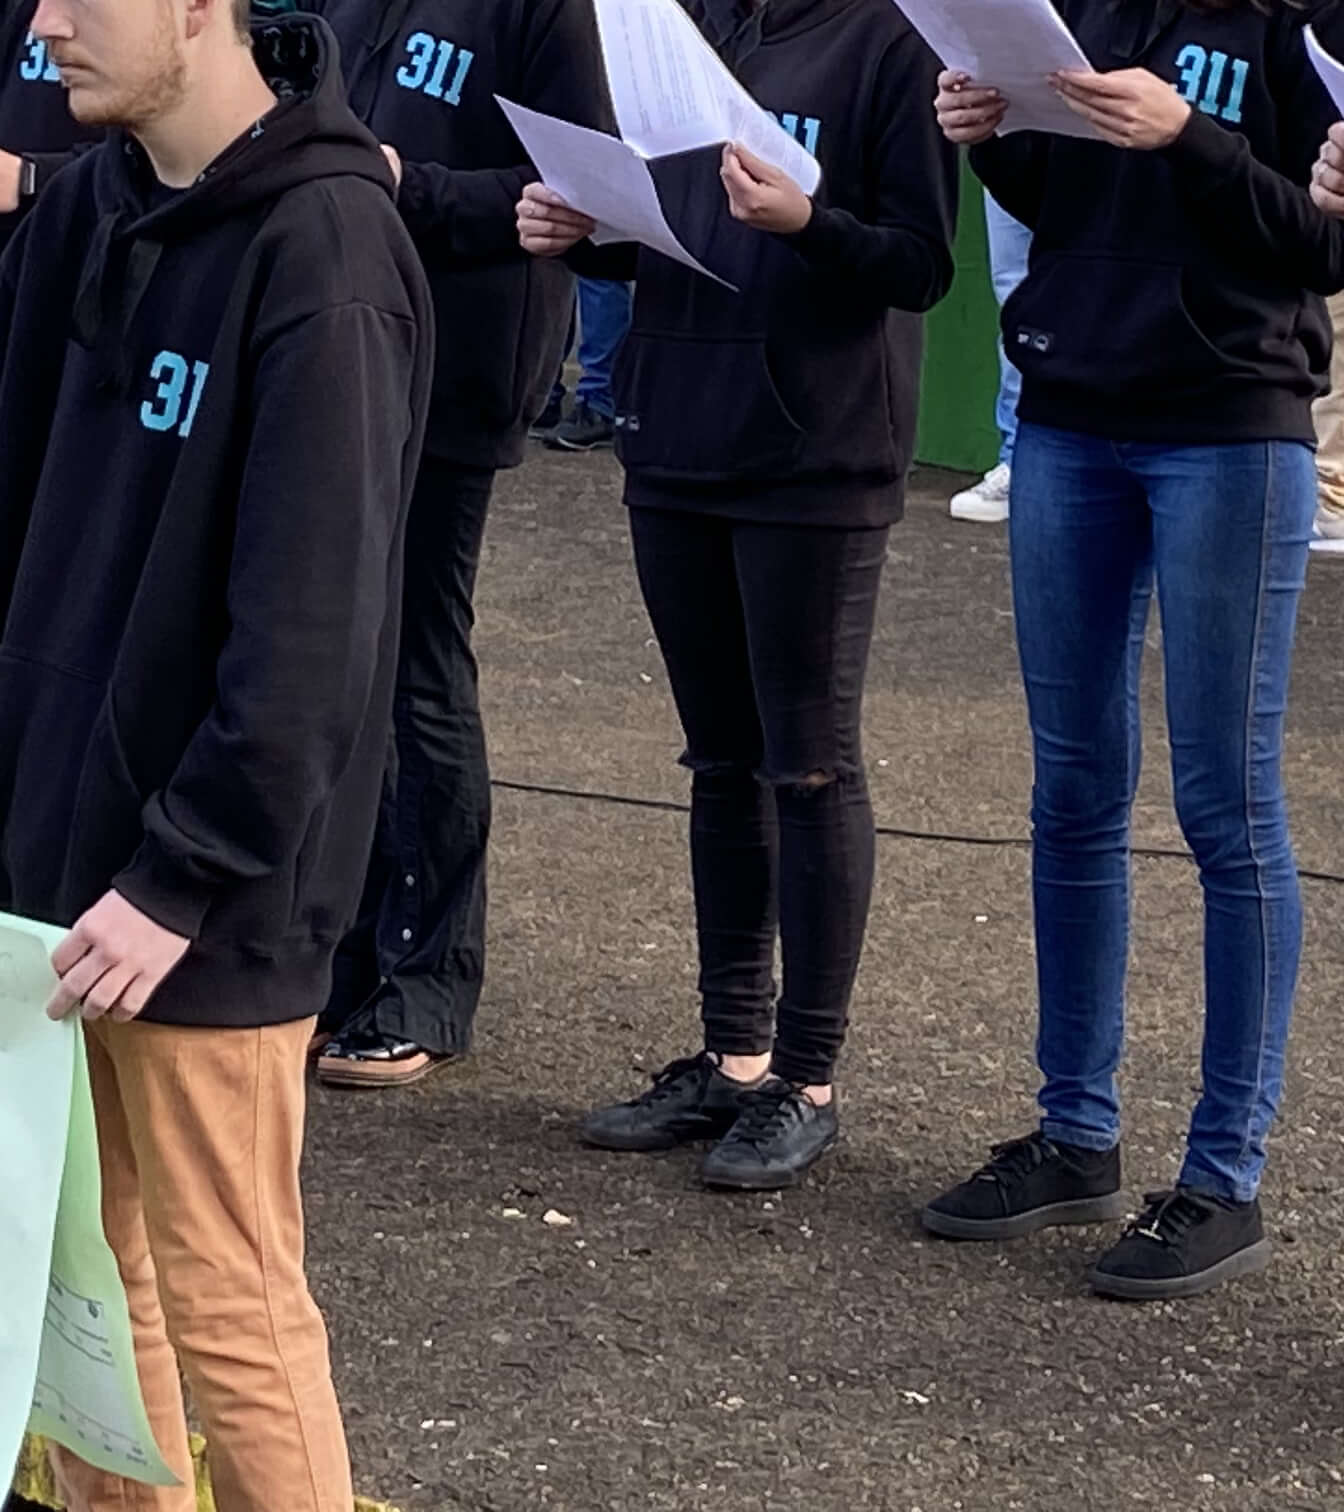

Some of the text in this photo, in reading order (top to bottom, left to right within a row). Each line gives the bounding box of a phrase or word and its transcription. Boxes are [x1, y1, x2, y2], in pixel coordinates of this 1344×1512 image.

[396, 31, 474, 106] 311
[1175, 43, 1250, 123] 311
[775, 113, 821, 156] 11
